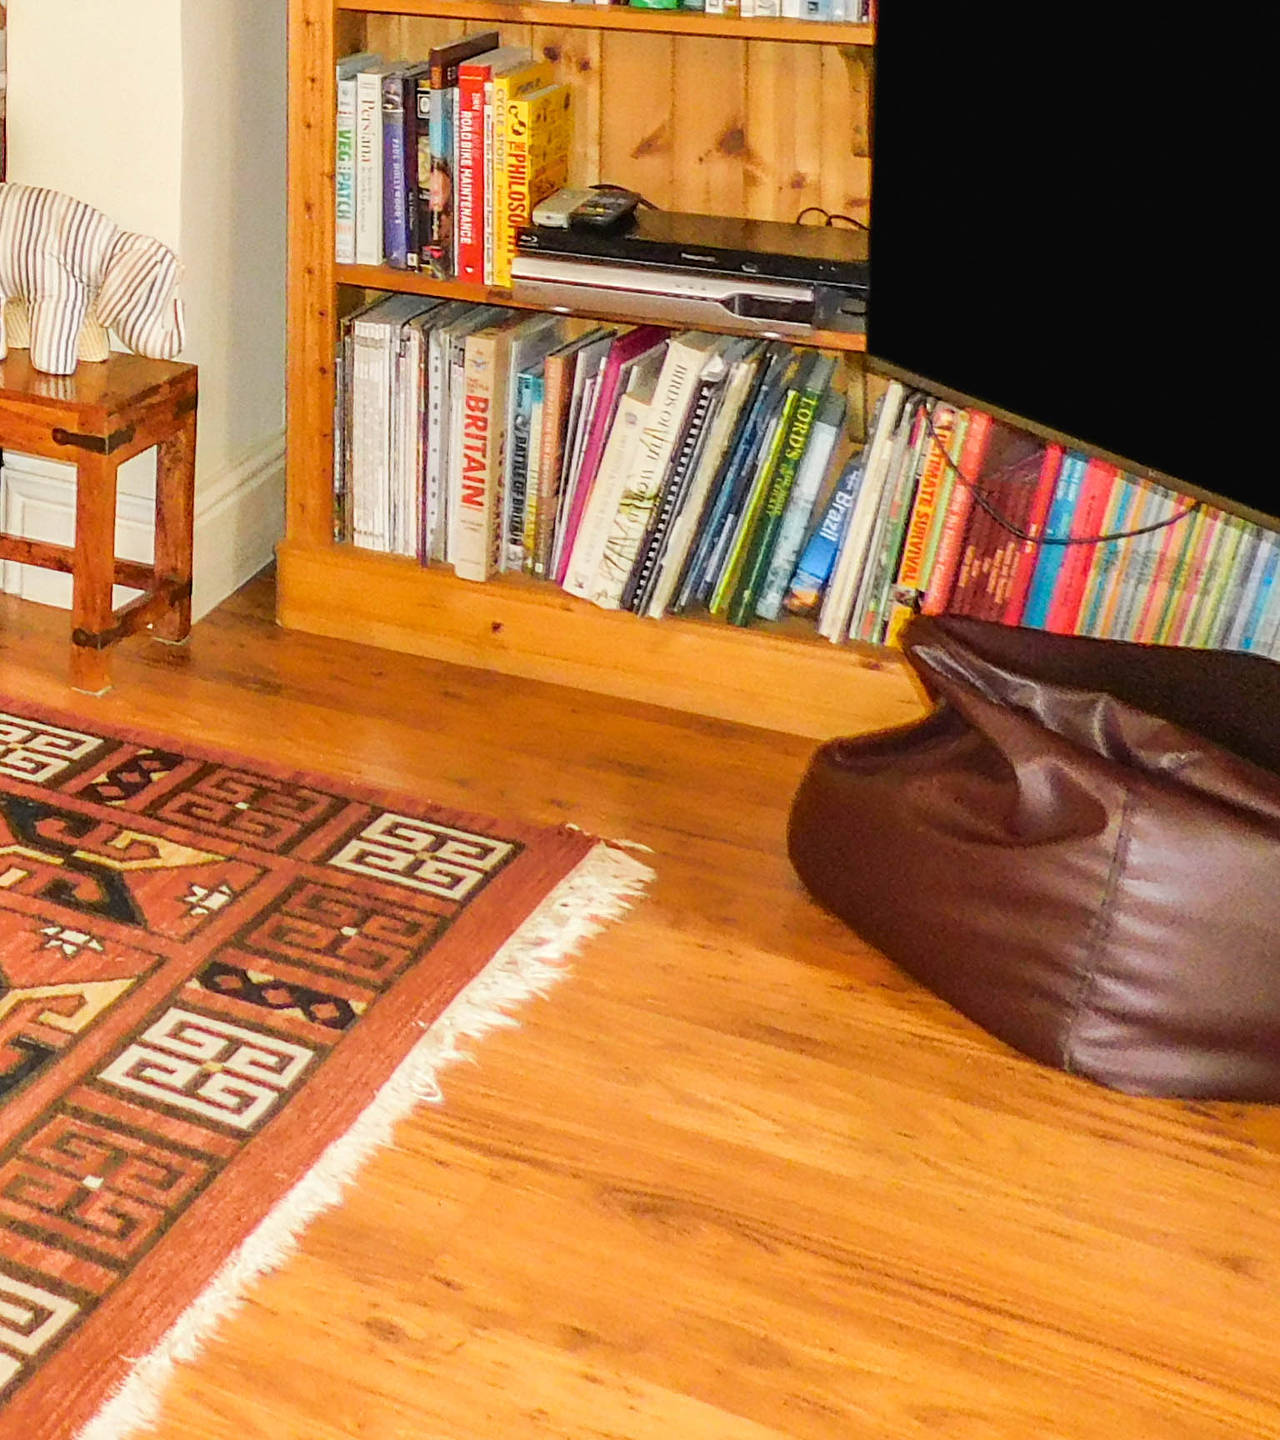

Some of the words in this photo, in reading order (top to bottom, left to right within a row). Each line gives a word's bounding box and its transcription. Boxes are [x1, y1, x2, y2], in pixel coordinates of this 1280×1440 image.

[360, 100, 376, 162] Persiana
[460, 110, 473, 140] ROAD
[496, 88, 505, 126] CYCLE
[338, 129, 352, 162] VEG
[392, 138, 400, 160] PAUL
[460, 141, 473, 166] BIKE
[496, 132, 505, 173] SPORT
[338, 171, 352, 220] PATCH
[459, 168, 473, 244] MAINTENANCE
[507, 153, 528, 254] PHILOSO
[663, 364, 688, 407] BIRDS
[461, 394, 489, 508] BRITAIN
[785, 396, 817, 460] LORD'S
[513, 435, 526, 478] BATTLE
[915, 429, 951, 506] ULTIMATE
[512, 480, 525, 495] OF
[509, 498, 524, 546] BRITAIN
[820, 490, 854, 541] Brazil
[902, 510, 932, 584] SURVIVAL
